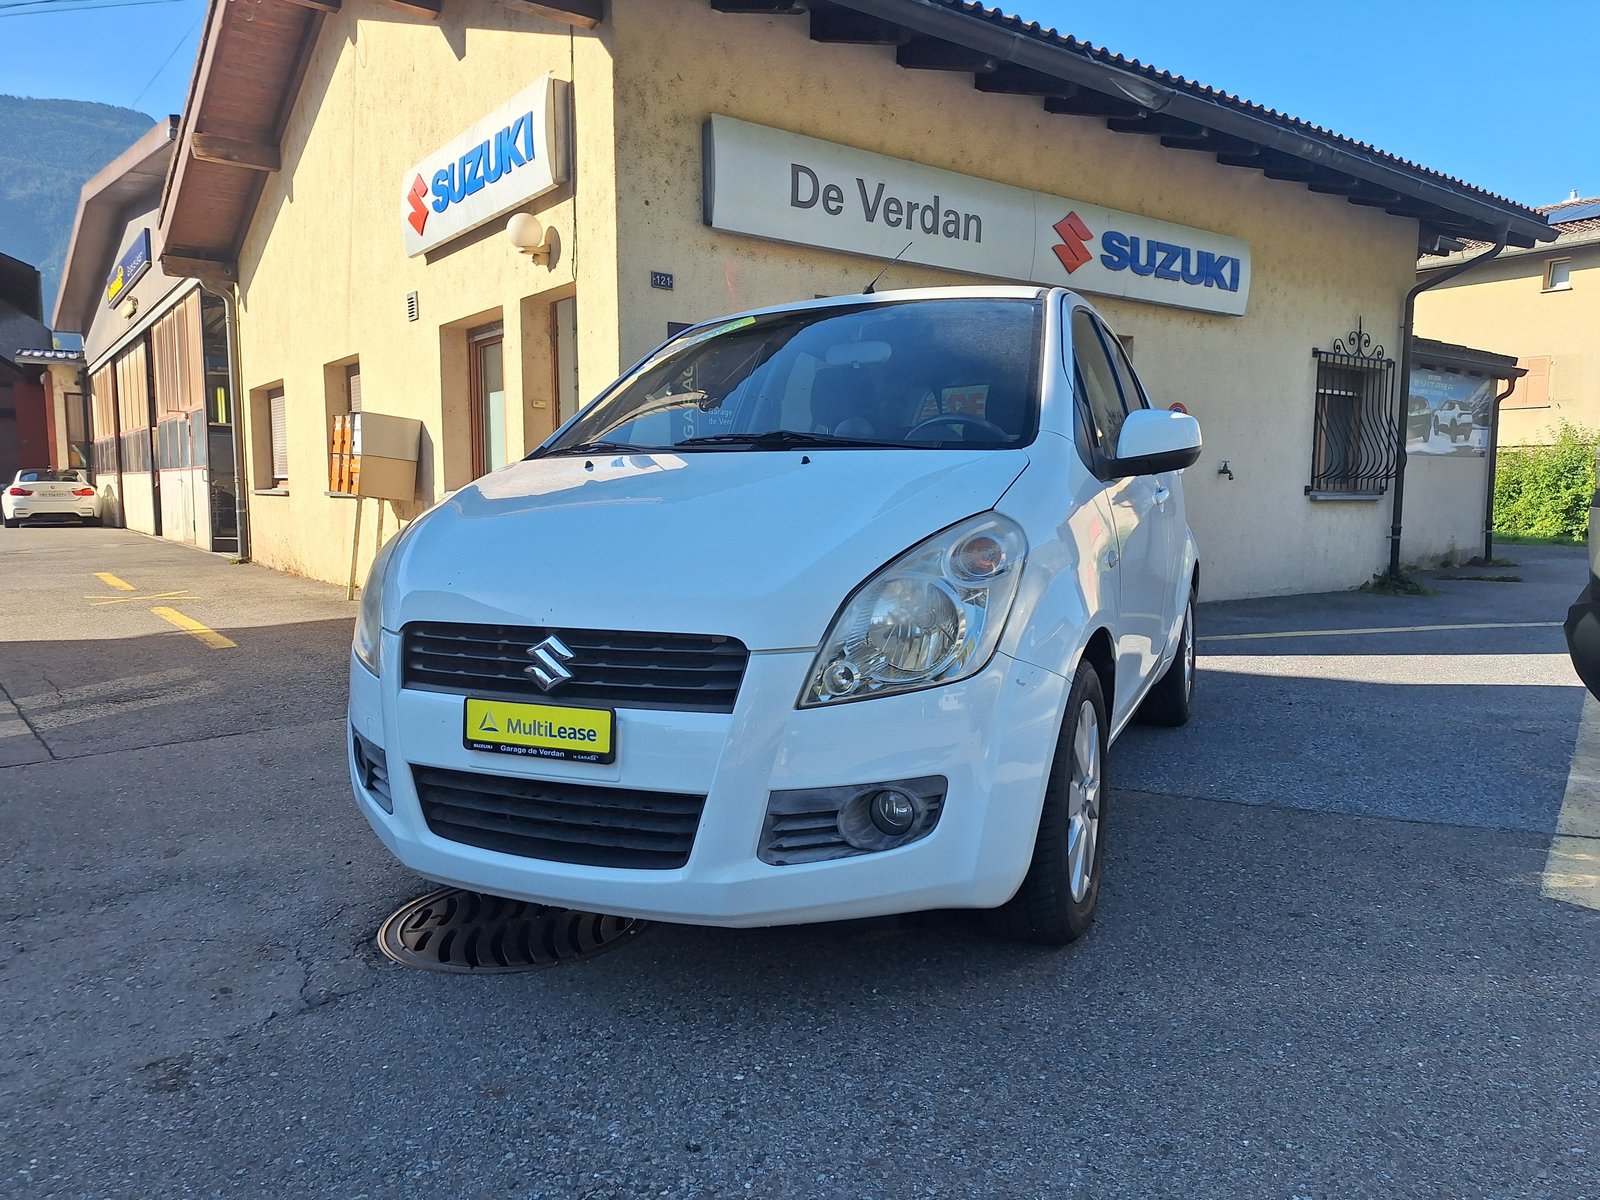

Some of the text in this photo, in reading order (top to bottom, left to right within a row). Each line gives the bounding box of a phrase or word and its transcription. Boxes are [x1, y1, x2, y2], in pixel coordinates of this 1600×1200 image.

[431, 111, 535, 213] SUZUKI
[790, 163, 983, 244] De Verdan
[1100, 230, 1240, 293] SUZUKI
[656, 275, 670, 286] 121
[709, 409, 733, 418] Garage
[506, 717, 597, 742] MultiLease
[500, 744, 527, 754] Garage
[527, 747, 537, 755] de
[538, 748, 565, 757] Verdan
